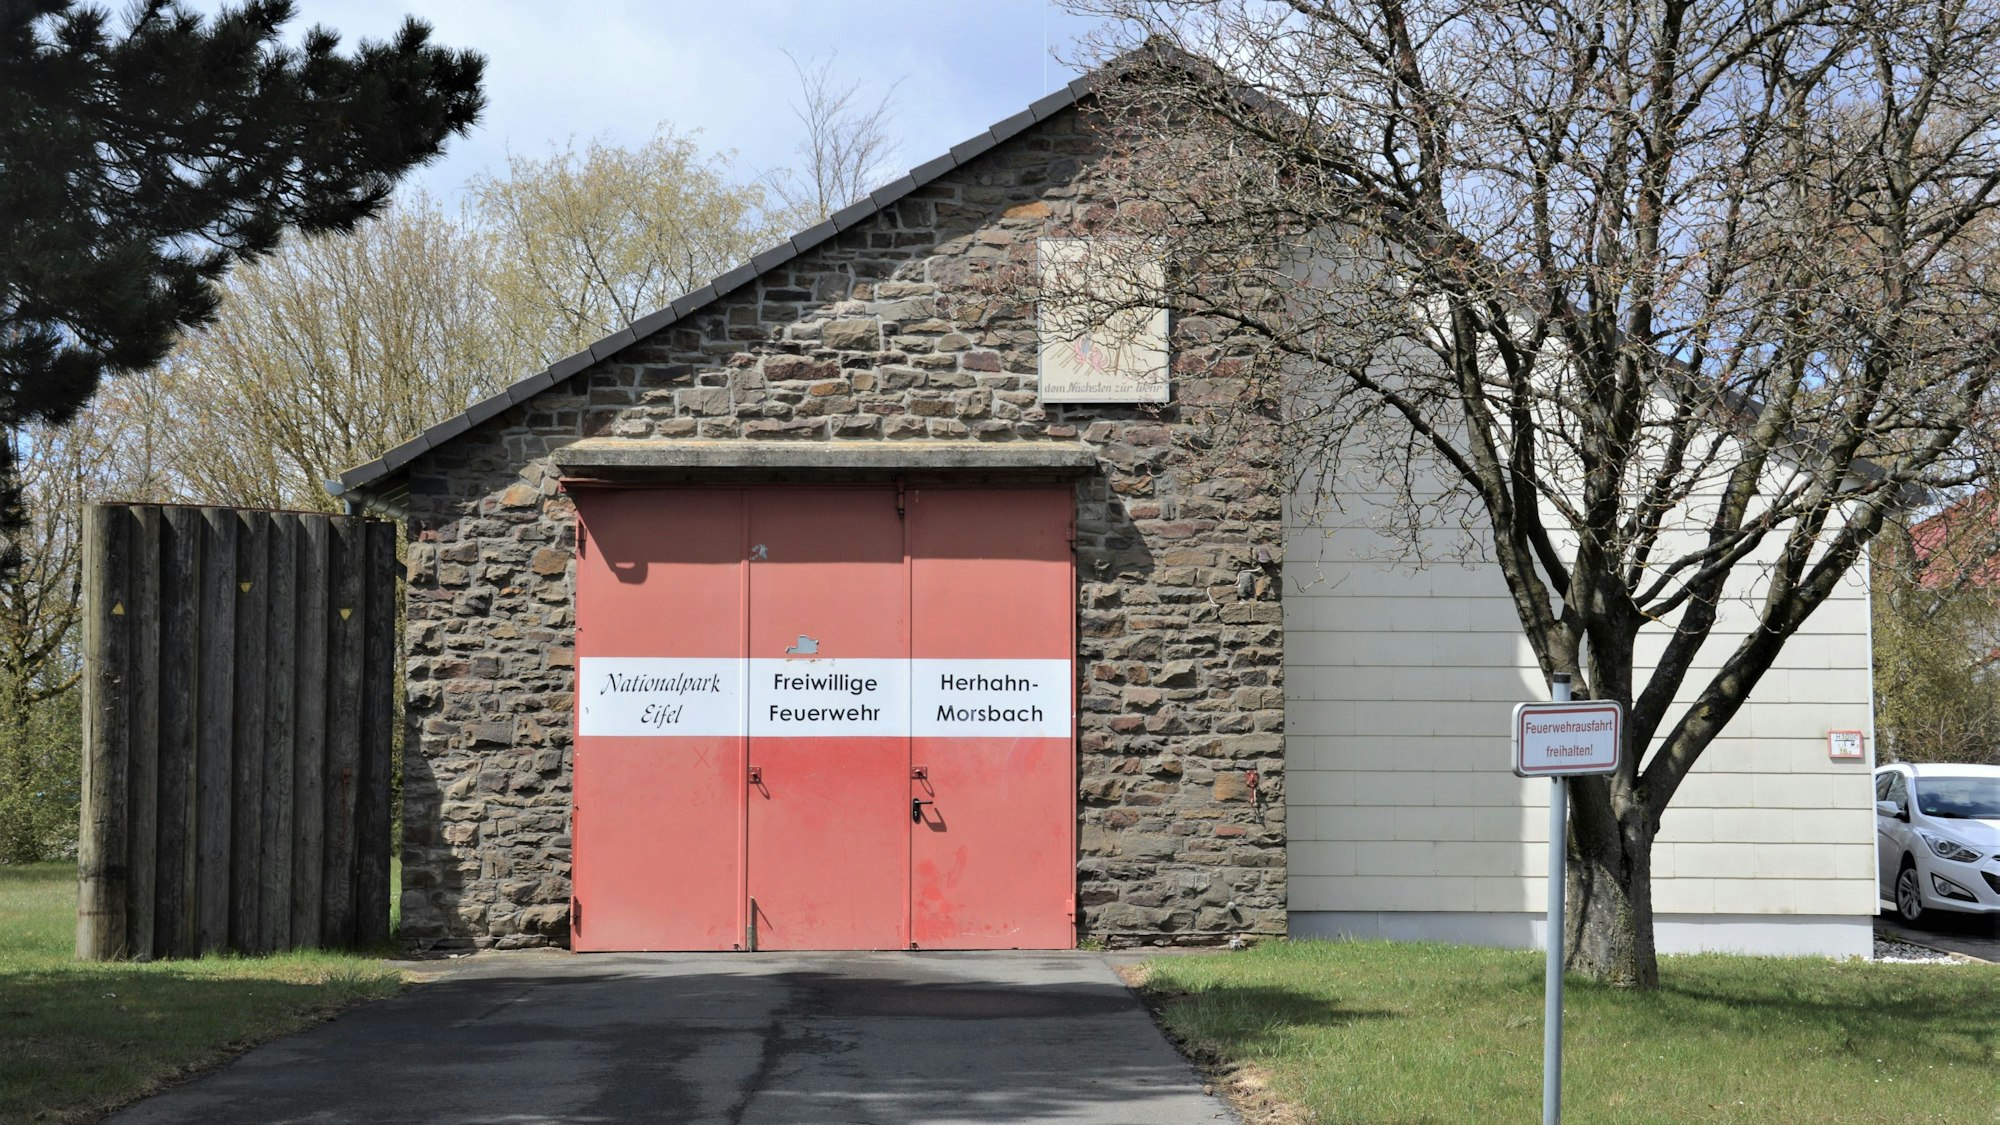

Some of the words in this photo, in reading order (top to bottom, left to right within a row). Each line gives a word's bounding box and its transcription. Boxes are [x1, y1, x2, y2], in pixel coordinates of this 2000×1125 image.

[1044, 383, 1065, 393] dem
[601, 673, 720, 696] Nationalpark
[774, 673, 878, 695] Freiwillige
[941, 674, 1039, 692] Herhahn-
[641, 703, 683, 729] Eifel
[770, 704, 881, 722] Feuerwehr
[937, 704, 1043, 722] Morsbach
[1525, 720, 1613, 734] Feuerwehrausfahrt
[1546, 744, 1593, 757] freihalten!
